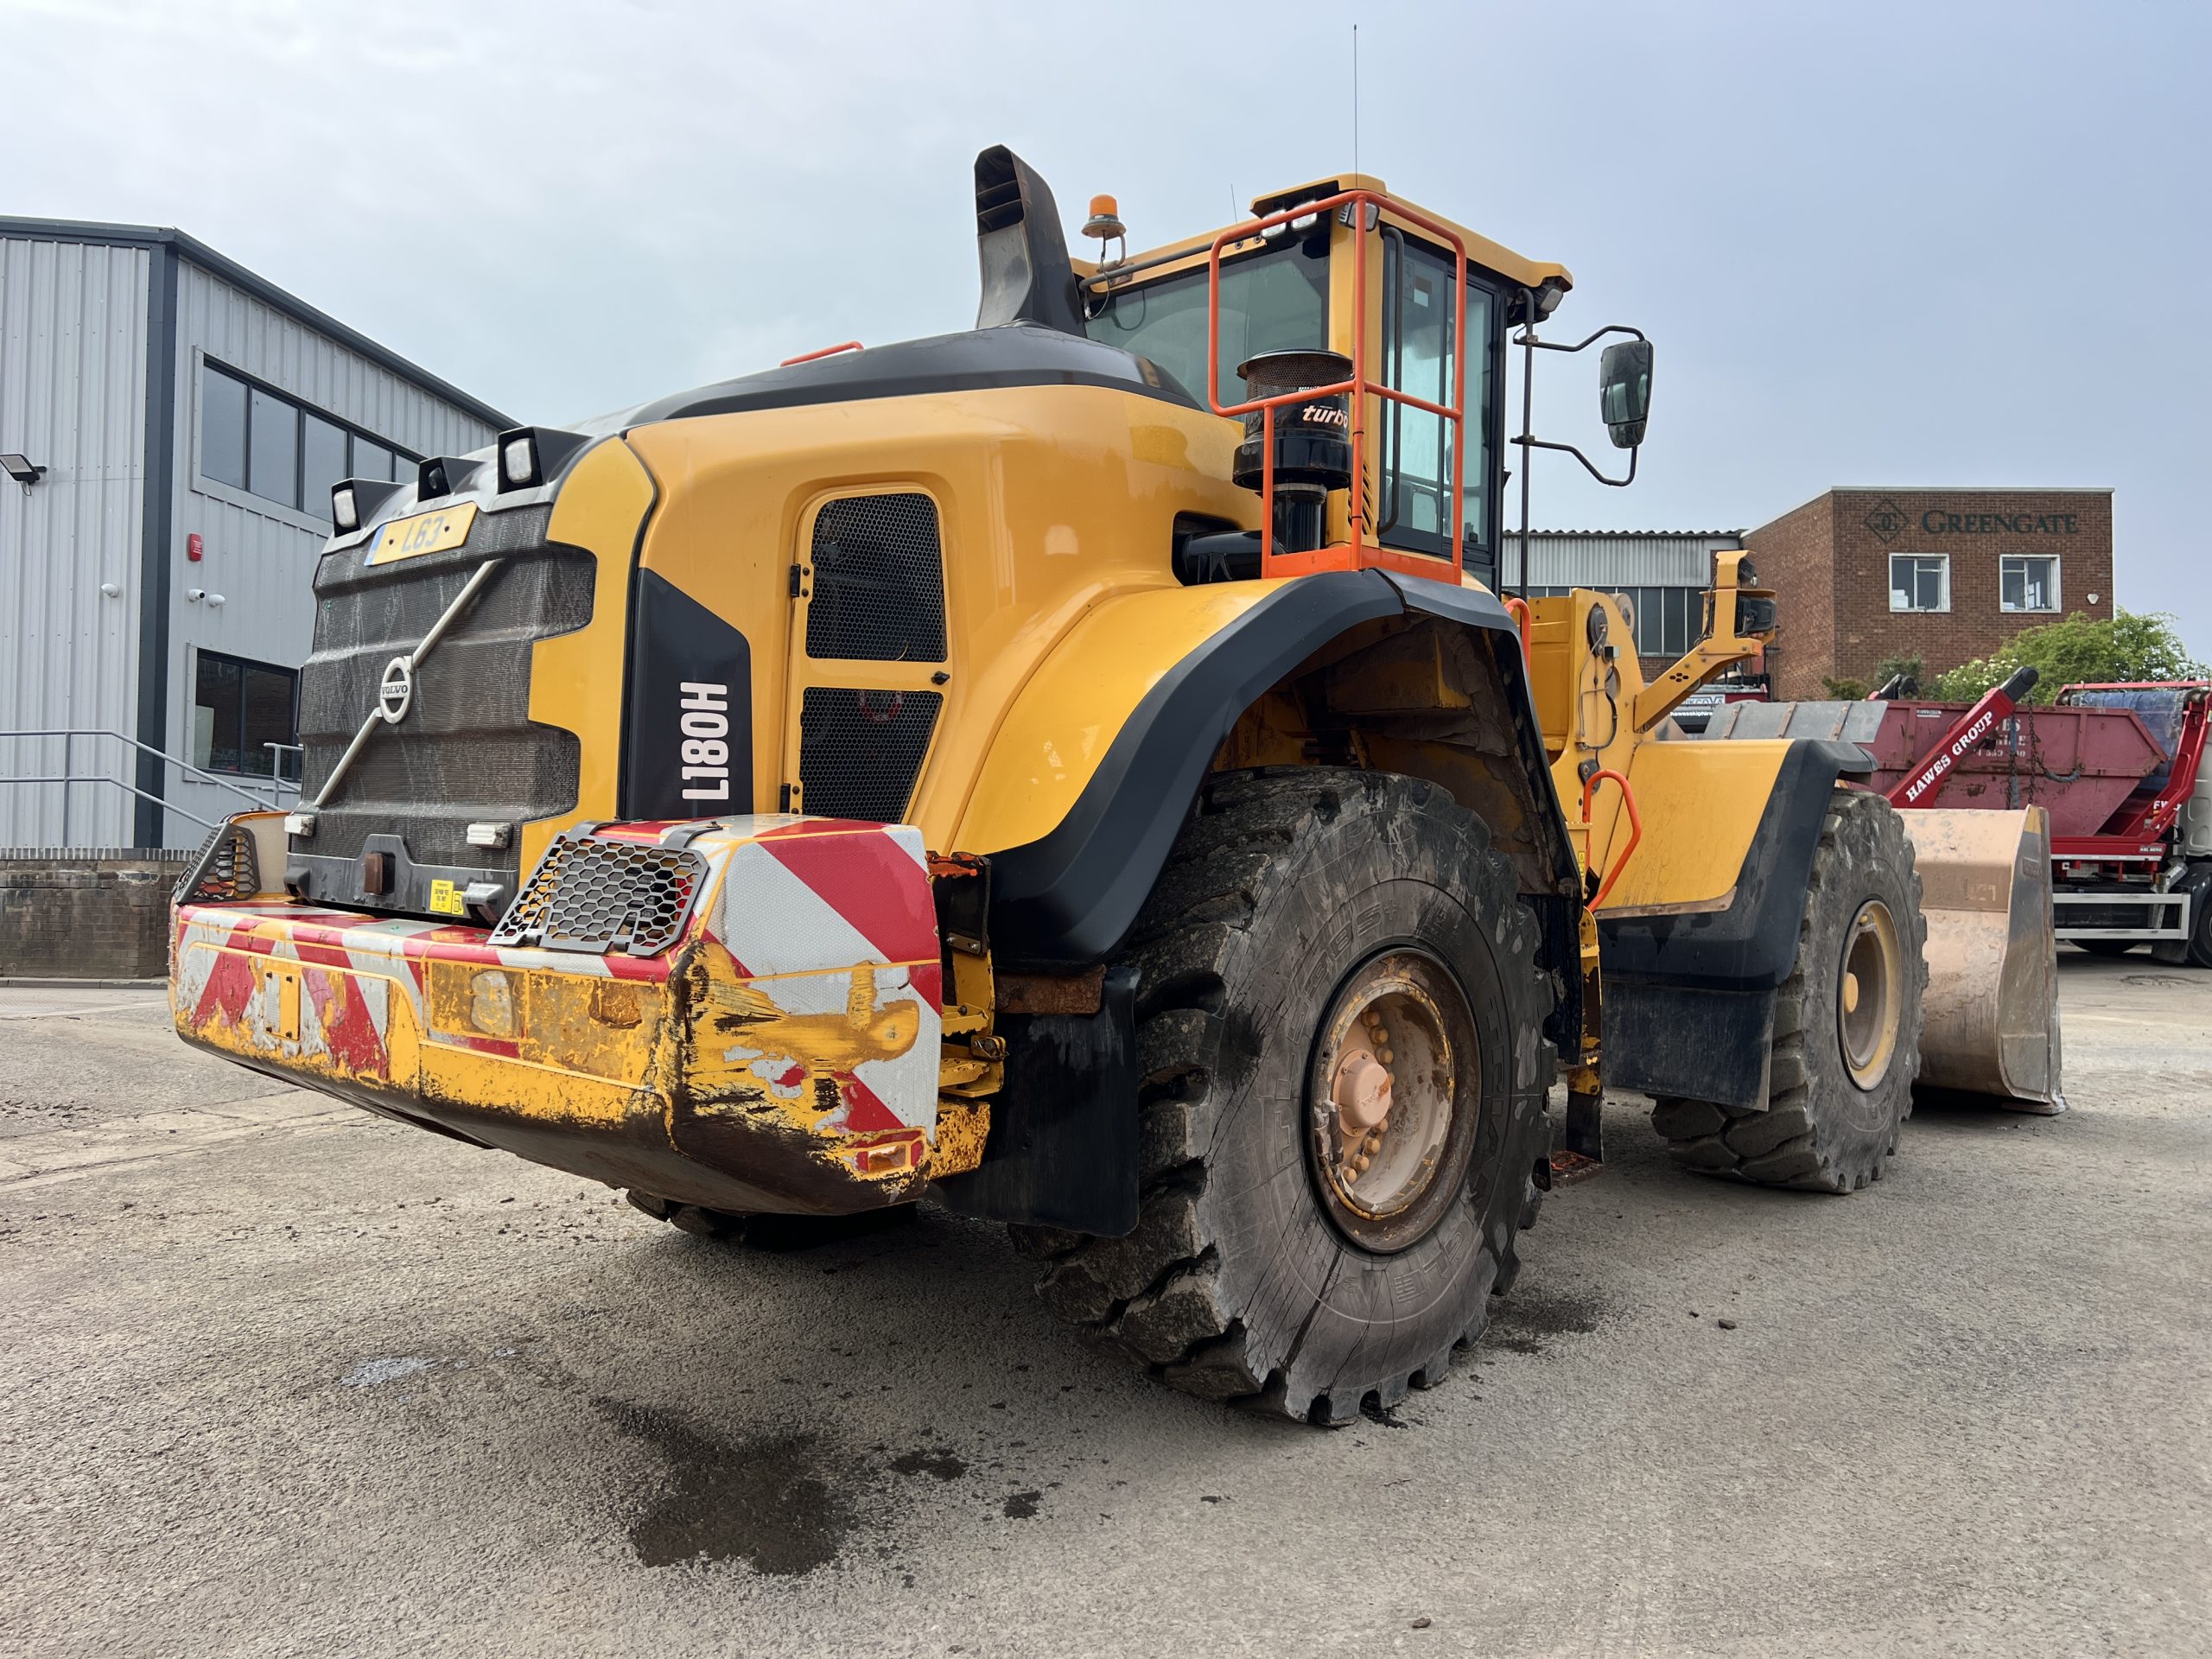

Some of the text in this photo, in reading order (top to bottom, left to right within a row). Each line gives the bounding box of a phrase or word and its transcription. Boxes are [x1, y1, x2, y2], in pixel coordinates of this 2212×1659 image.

[1302, 404, 1348, 429] turbo
[401, 516, 444, 553] L63
[1922, 510, 2079, 534] GREENGATE
[382, 685, 408, 695] VOLVO
[680, 682, 729, 800] L180H
[1905, 753, 1951, 803] HAWES
[1952, 710, 1993, 756] GROUP
